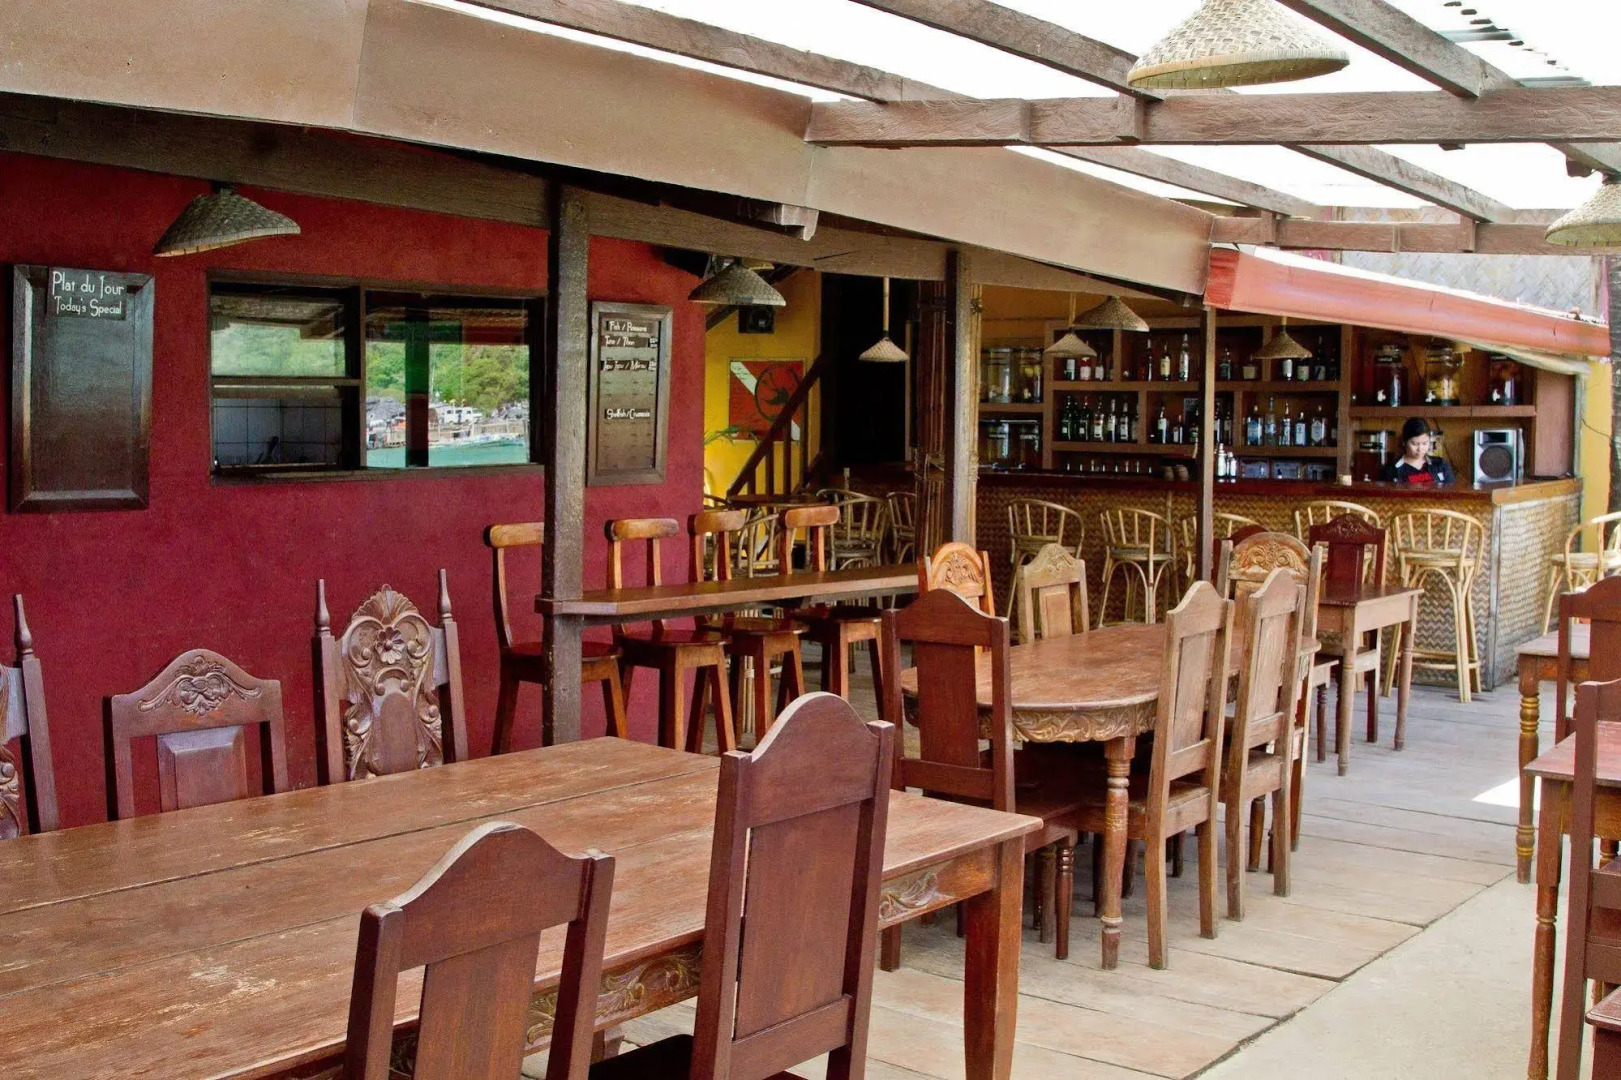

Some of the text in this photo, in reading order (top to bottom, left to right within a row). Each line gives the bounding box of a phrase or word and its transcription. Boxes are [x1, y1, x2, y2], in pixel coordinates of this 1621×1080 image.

[52, 271, 124, 299] Plat du Jour
[54, 295, 122, 317] Today's Special
